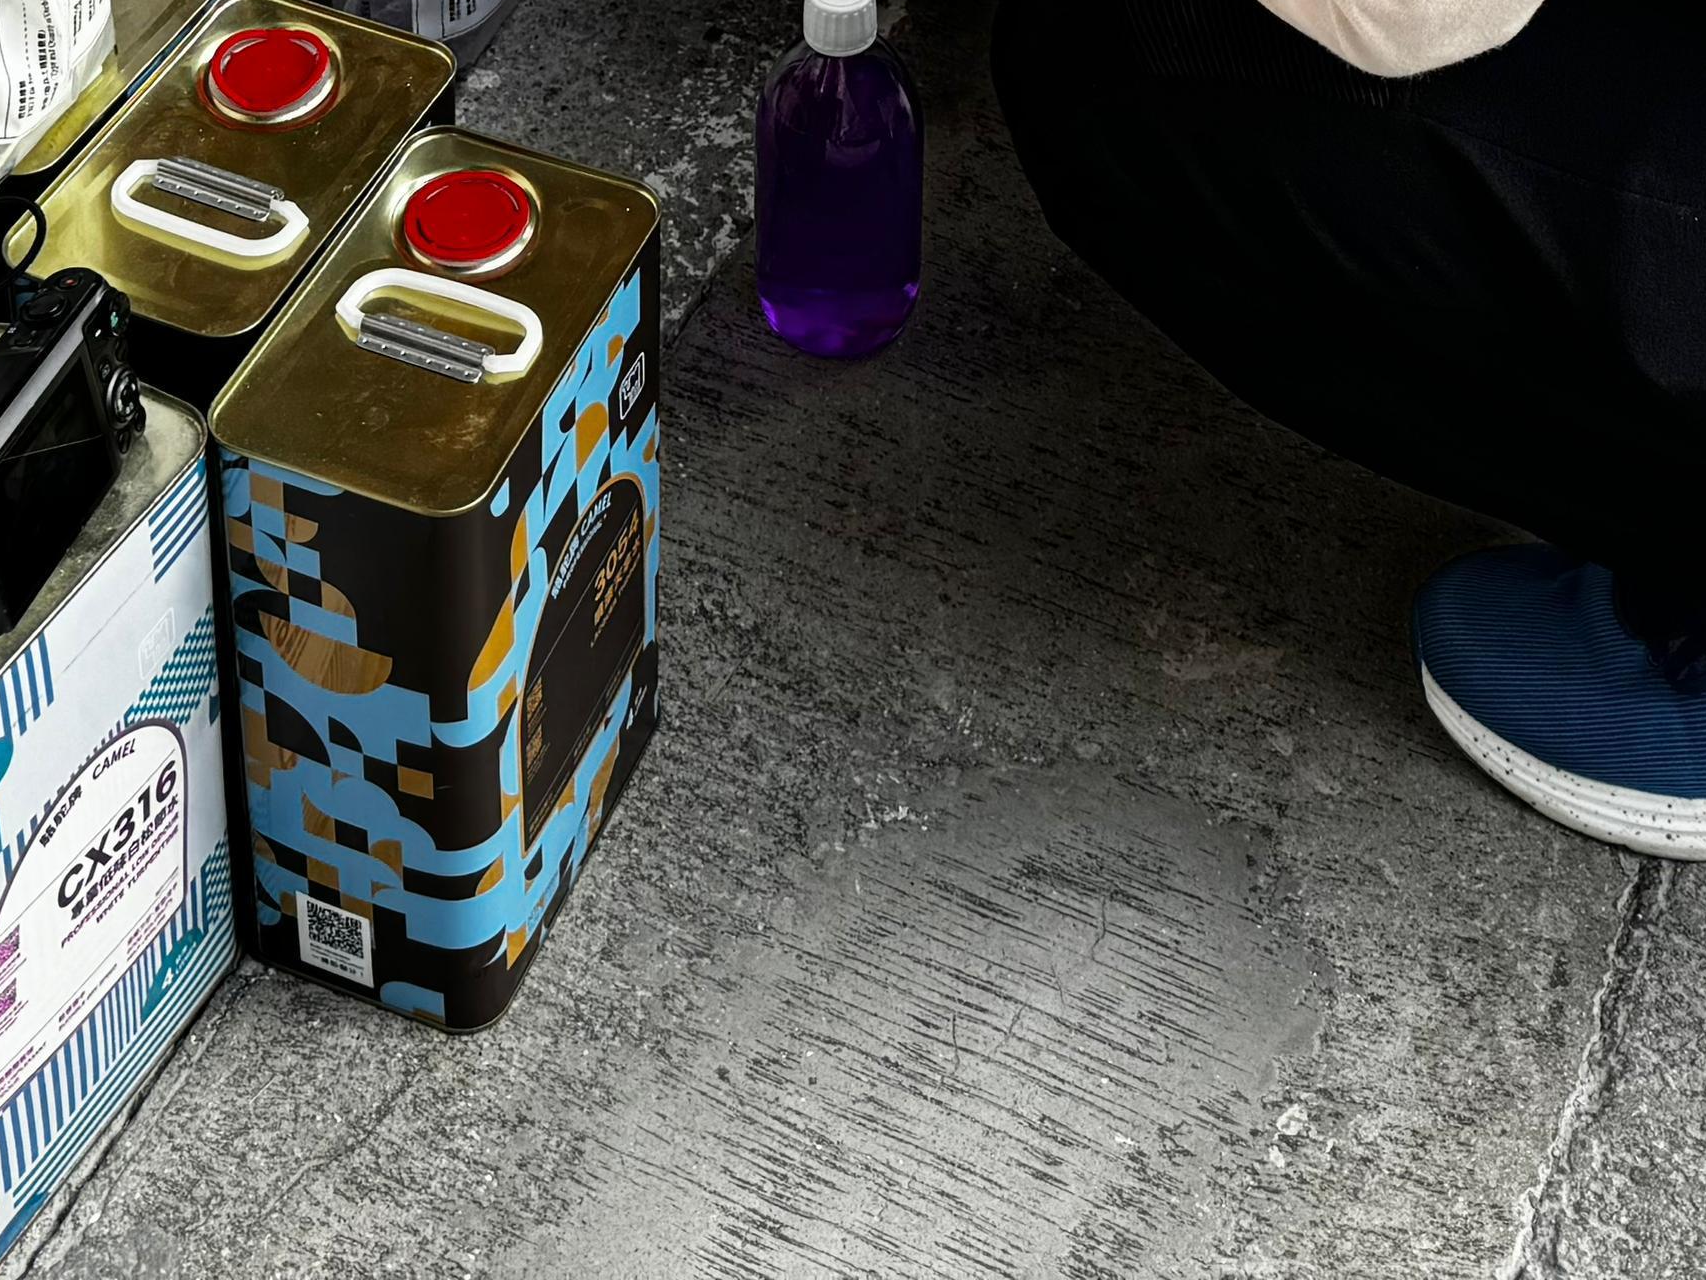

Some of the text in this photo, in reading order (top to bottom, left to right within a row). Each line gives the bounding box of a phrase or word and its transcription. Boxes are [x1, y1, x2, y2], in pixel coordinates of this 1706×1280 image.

[92, 738, 136, 781] CAMEL
[56, 759, 178, 909] CX316
[61, 872, 130, 950] PROFESSIONAL
